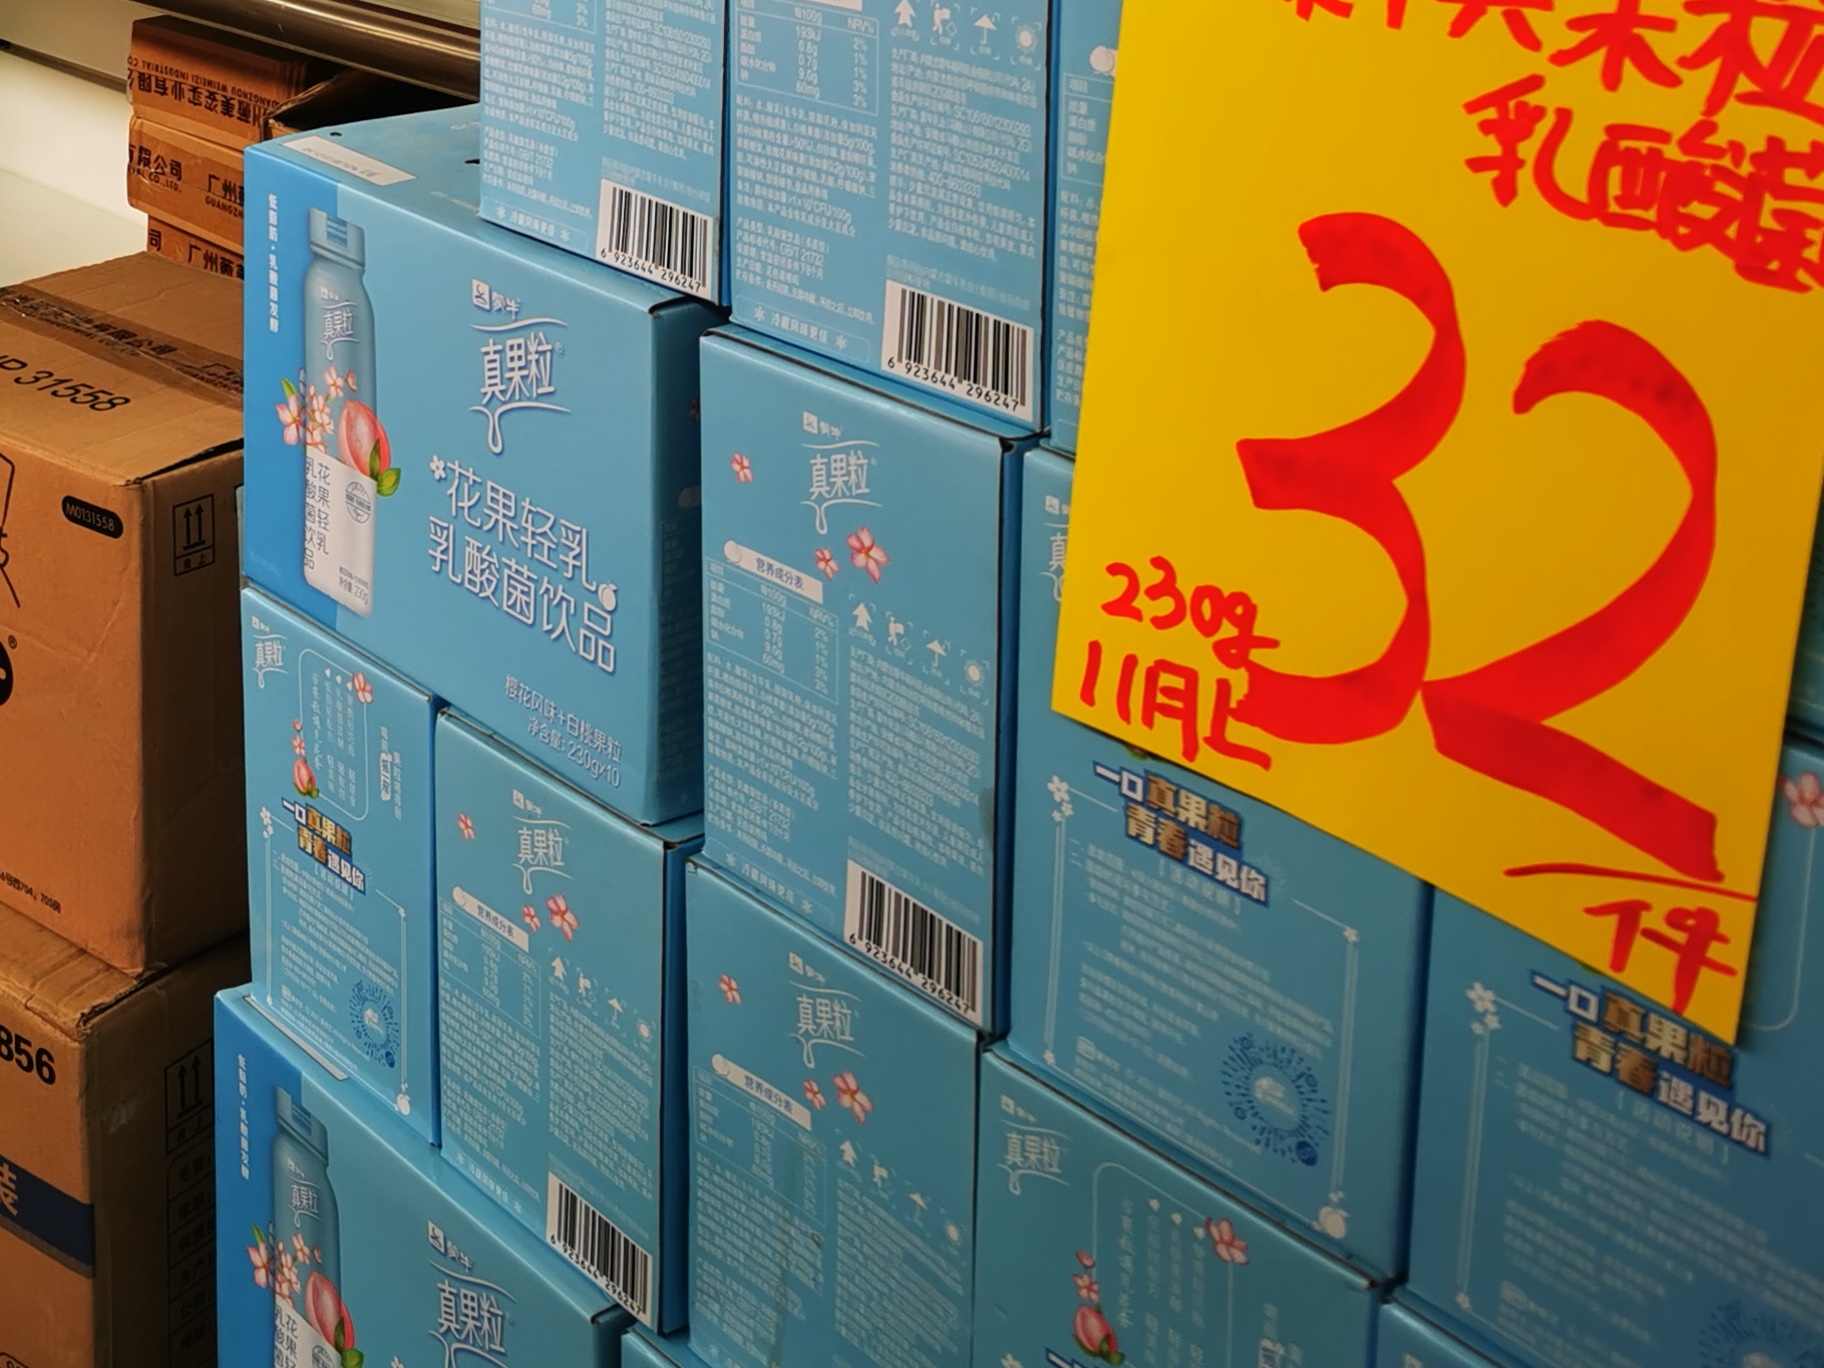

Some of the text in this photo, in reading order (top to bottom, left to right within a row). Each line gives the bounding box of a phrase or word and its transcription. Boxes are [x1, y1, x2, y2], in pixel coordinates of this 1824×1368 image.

[148, 230, 162, 251] 司
[600, 247, 701, 293] 6 923644 296247
[323, 308, 354, 341] 真果粒
[492, 291, 520, 320] 蒙牛
[771, 311, 828, 344] 冷藏风味更佳
[479, 330, 555, 405] 真果粒
[887, 356, 1020, 412] 6 923644 296247
[809, 449, 871, 501] 真果粒
[65, 503, 116, 533] M0131558
[448, 459, 596, 592] 花果轻乳
[755, 556, 804, 592] 营养成分表
[1236, 211, 1726, 883] 32
[426, 515, 615, 675] 乳酸菌饮品
[1100, 555, 1280, 668] 230g
[254, 640, 284, 669] 真果粒
[505, 673, 621, 764] 樱花风味+白桃果粒
[281, 797, 352, 857] 一口真果粒
[1094, 761, 1243, 849] 一口真果粒
[298, 827, 366, 894] 青春遇见你
[517, 826, 565, 867] 真果粒
[1125, 802, 1268, 903] 青春遇见你
[477, 903, 515, 940] 营养成分表
[848, 932, 971, 1017] 6 923644 296247
[796, 993, 853, 1041] 真果粒
[1532, 971, 1733, 1089] 一口真果粒
[1573, 1029, 1770, 1155] 青春遇见你
[1004, 1131, 1061, 1174] 真果粒
[291, 1183, 319, 1214] 真果粒
[446, 1240, 473, 1273] 蒙牛
[436, 1279, 507, 1354] 真果粒
